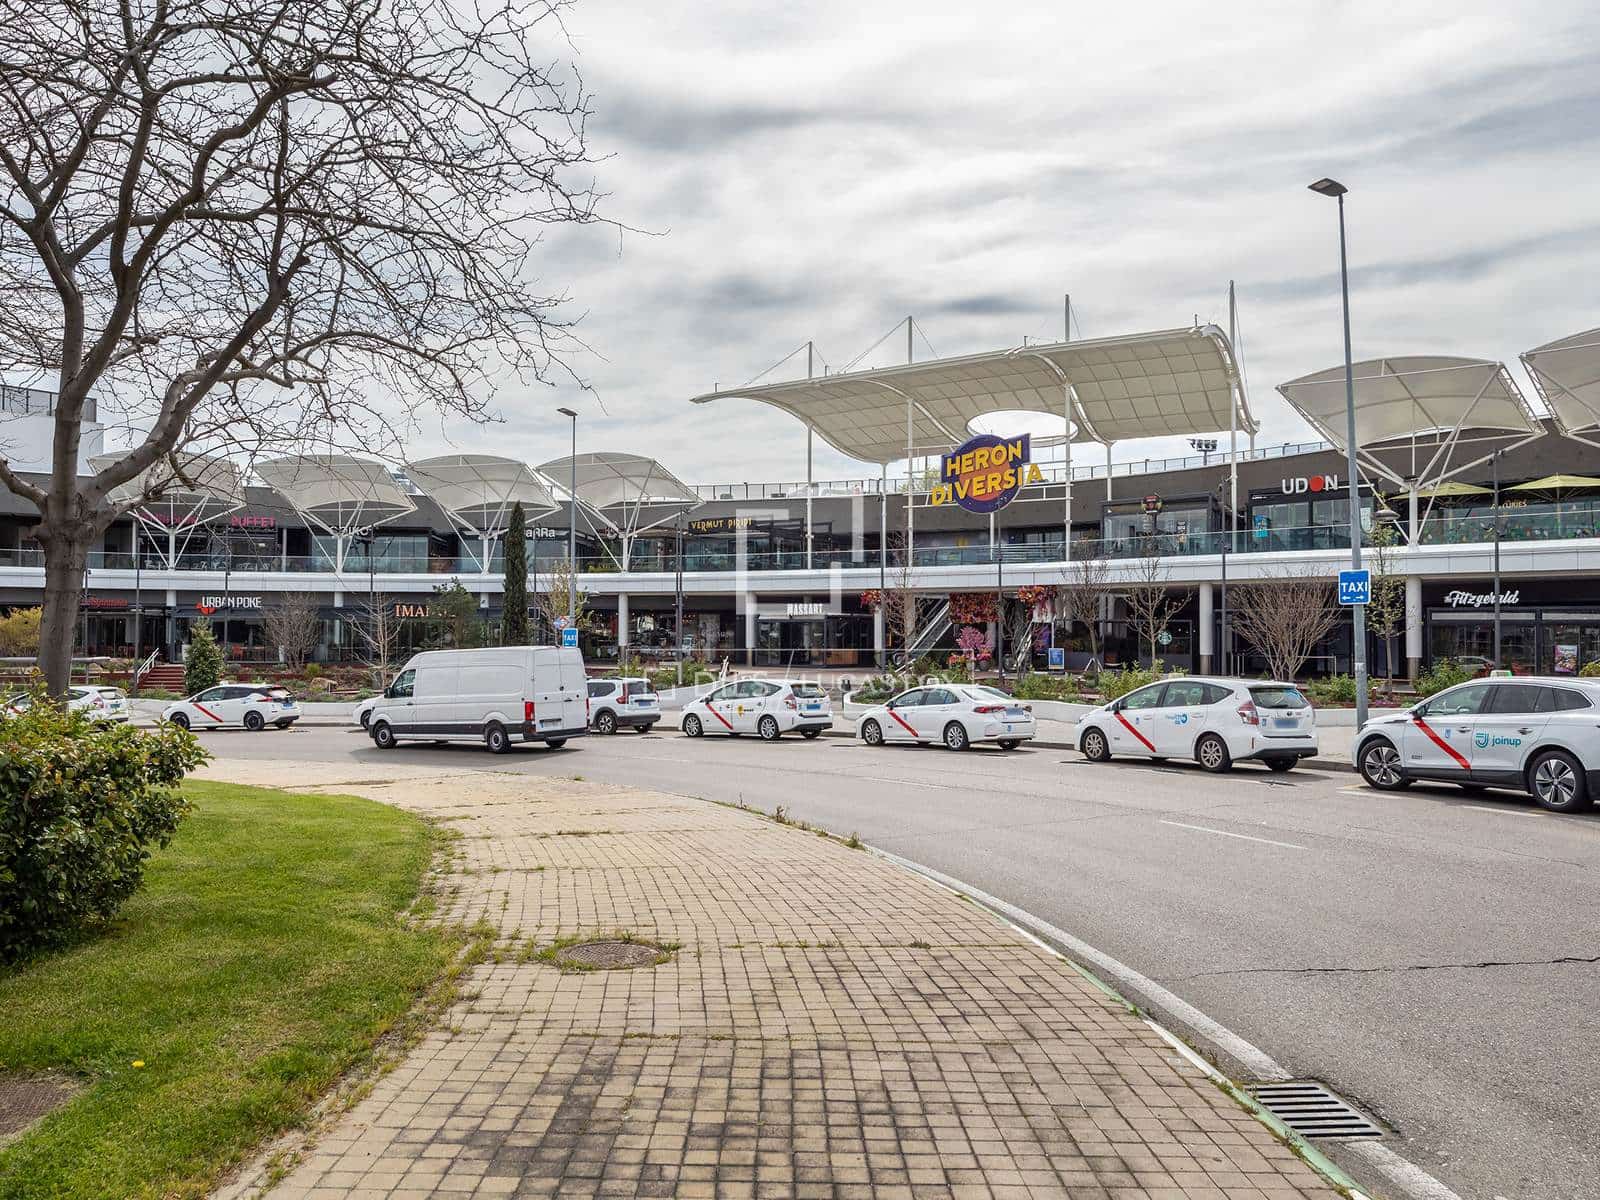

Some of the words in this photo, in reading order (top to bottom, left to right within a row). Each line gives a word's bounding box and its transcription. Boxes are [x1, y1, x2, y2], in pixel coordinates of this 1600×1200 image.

[946, 440, 1022, 477] HERON
[931, 463, 1044, 506] DIVERSIA
[1281, 474, 1339, 494] UDON
[691, 520, 724, 531] VERMUT
[1340, 582, 1368, 593] TAXI
[201, 596, 235, 608] URBAN
[236, 596, 262, 608] POKE
[1491, 735, 1522, 748] joinup
